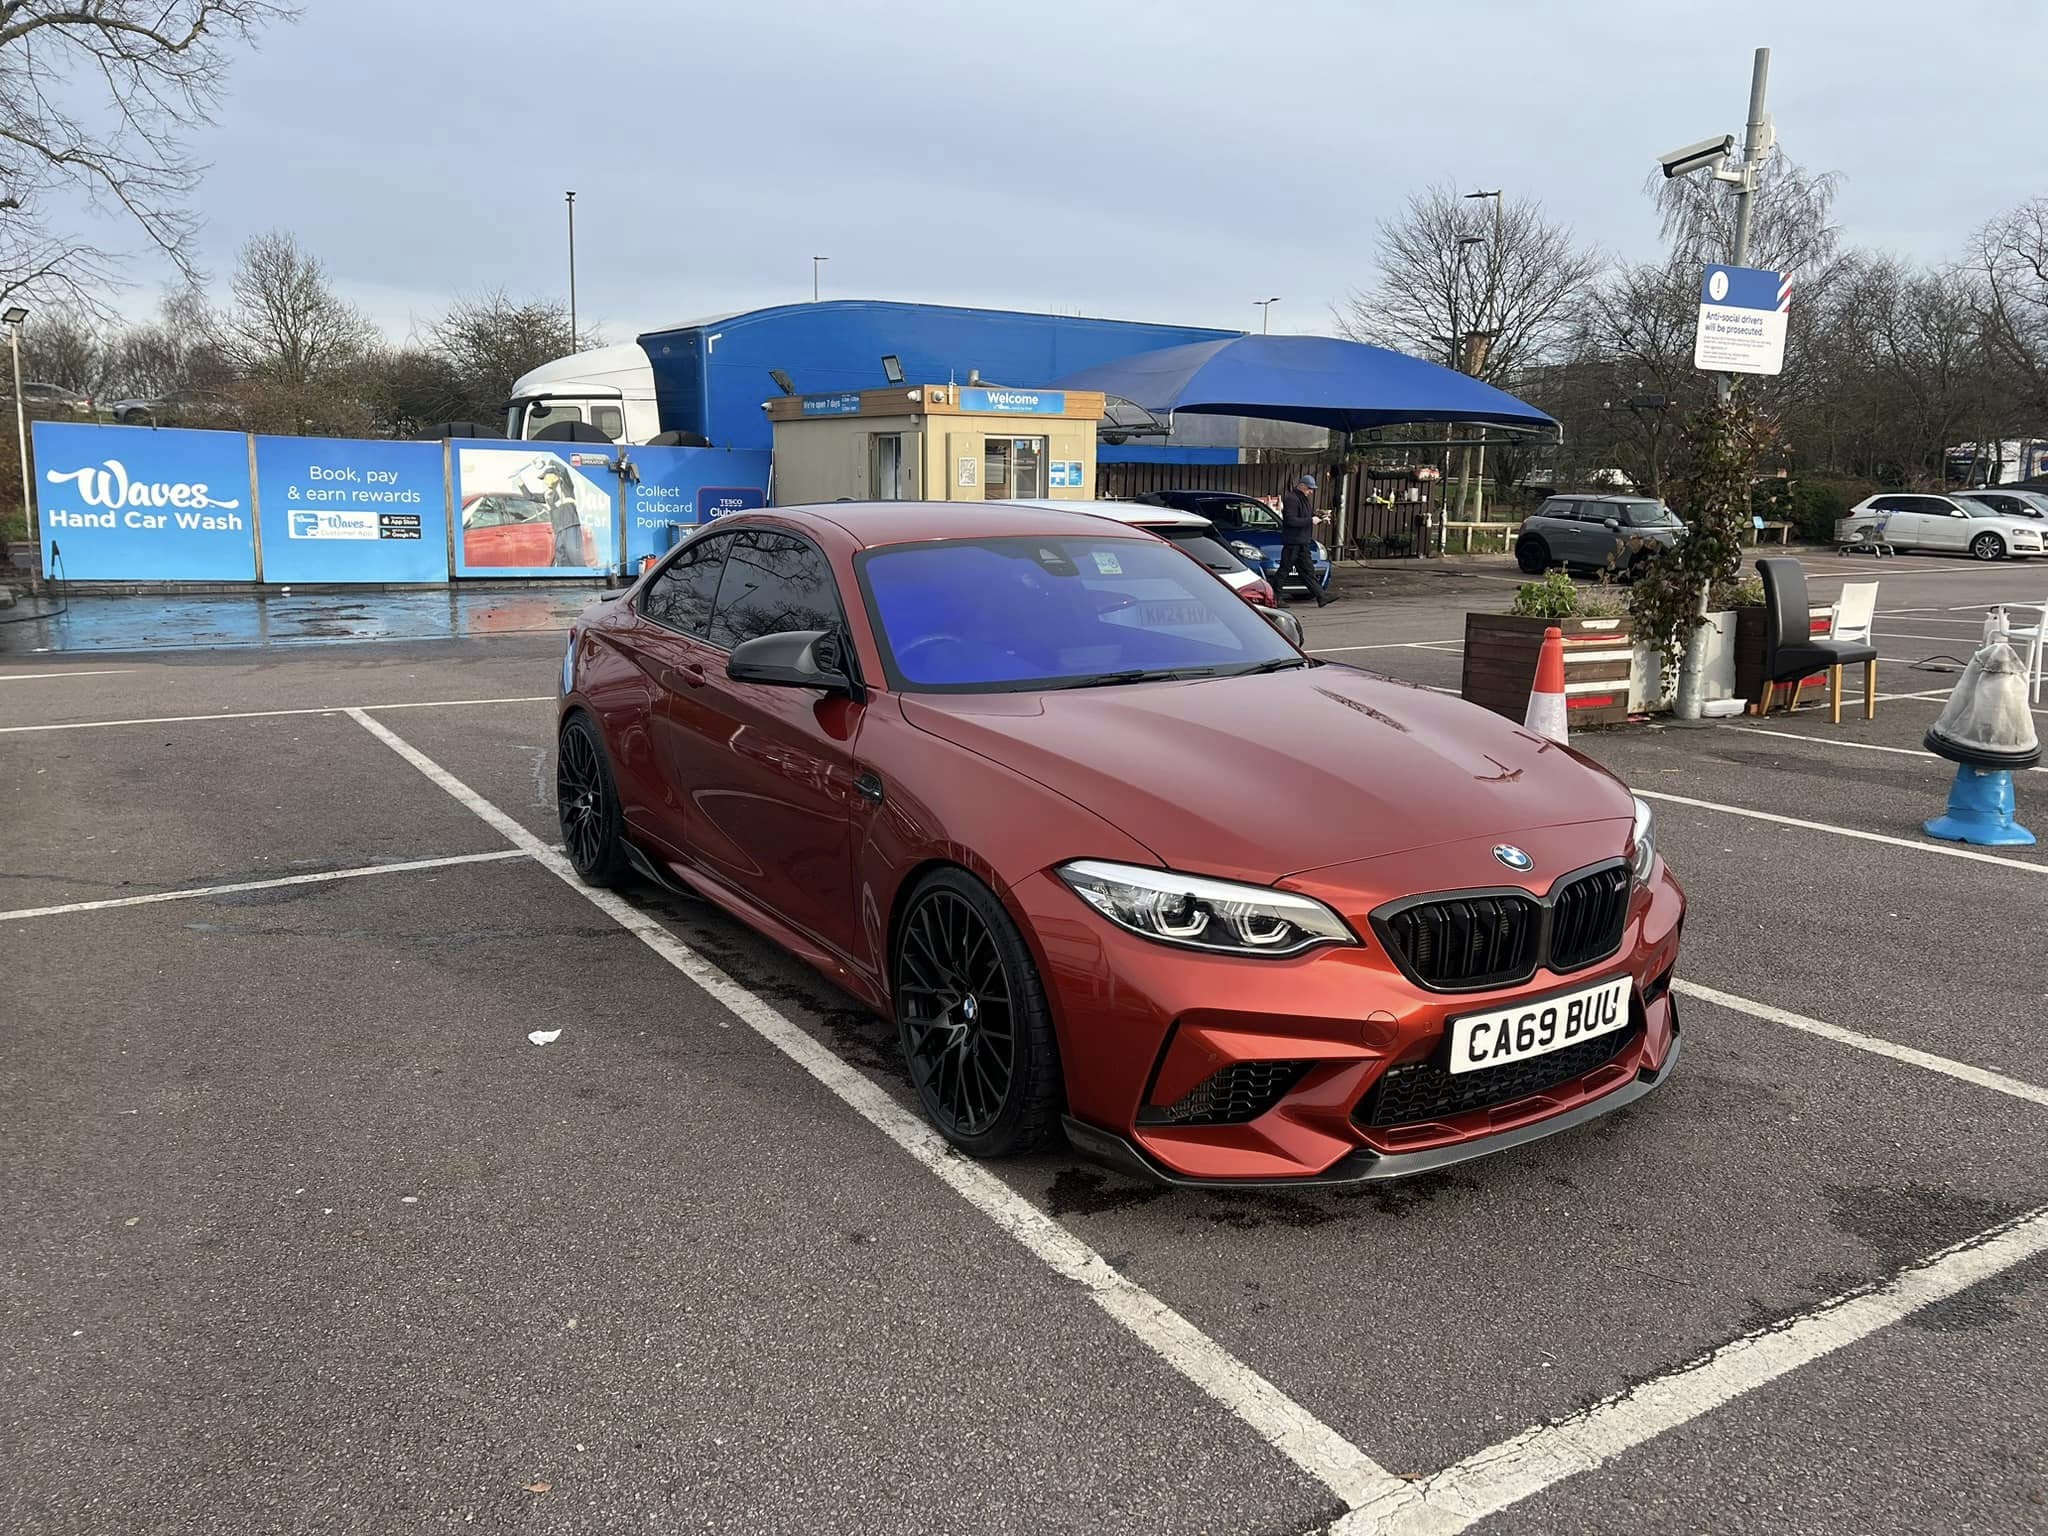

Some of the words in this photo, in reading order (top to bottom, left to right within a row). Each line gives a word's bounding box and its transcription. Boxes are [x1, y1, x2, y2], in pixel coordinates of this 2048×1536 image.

[1706, 311, 1741, 323] Anti-social
[1741, 315, 1764, 325] drivers
[1704, 323, 1717, 332] will
[1717, 324, 1727, 333] be
[1726, 326, 1764, 336] prosecuted.
[987, 391, 1039, 405] Welcome
[309, 465, 361, 483] Book,
[367, 470, 398, 485] pay
[47, 459, 240, 509] Waves
[287, 485, 300, 500] &
[306, 488, 346, 501] earn
[352, 488, 421, 503] rewards
[636, 485, 680, 498] Collect
[636, 501, 693, 513] Clubcard
[719, 498, 743, 506] TESCO
[49, 509, 116, 528] Hand
[124, 511, 168, 529] Car
[174, 512, 243, 530] Wash
[320, 514, 373, 529] Waves
[1468, 1007, 1557, 1062] CA69
[1564, 986, 1621, 1040] BUU
